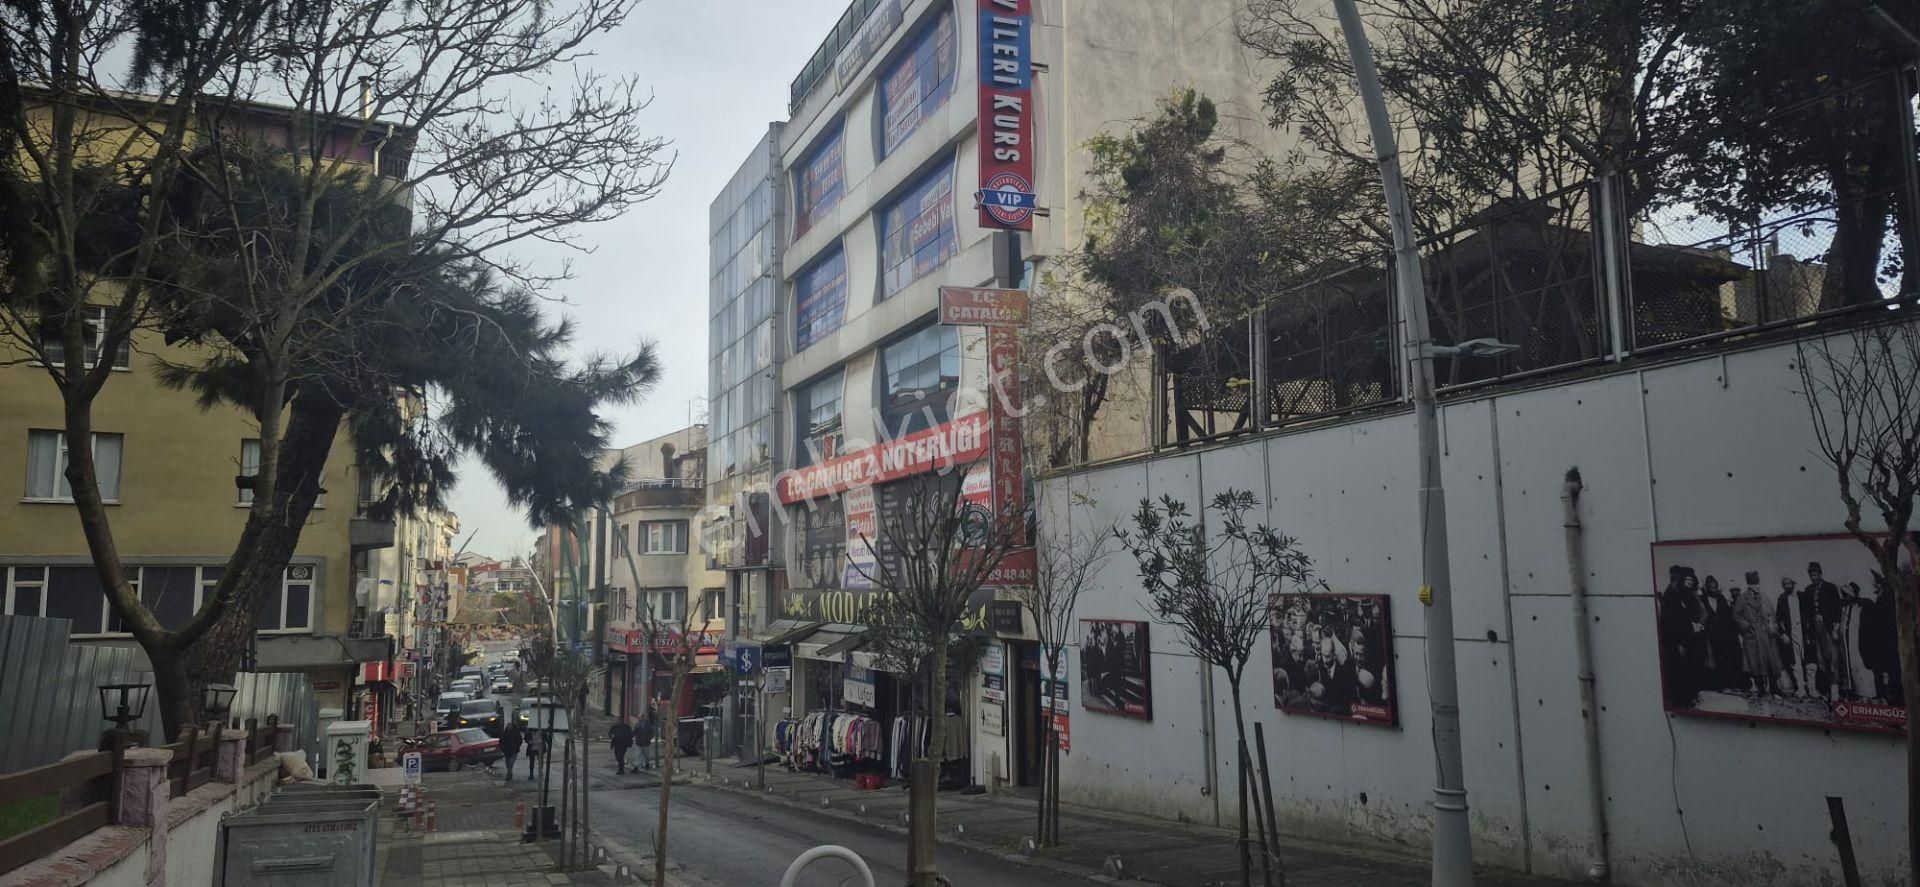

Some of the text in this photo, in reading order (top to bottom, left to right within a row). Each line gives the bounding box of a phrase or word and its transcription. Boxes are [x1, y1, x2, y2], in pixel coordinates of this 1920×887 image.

[992, 16, 1022, 85] İLERİ
[993, 94, 1022, 163] KURS
[940, 202, 954, 220] Va
[997, 192, 1022, 205] VIP
[882, 416, 982, 472] NOTERLİĞİ
[1852, 705, 1906, 719] ERHANGÜZ
